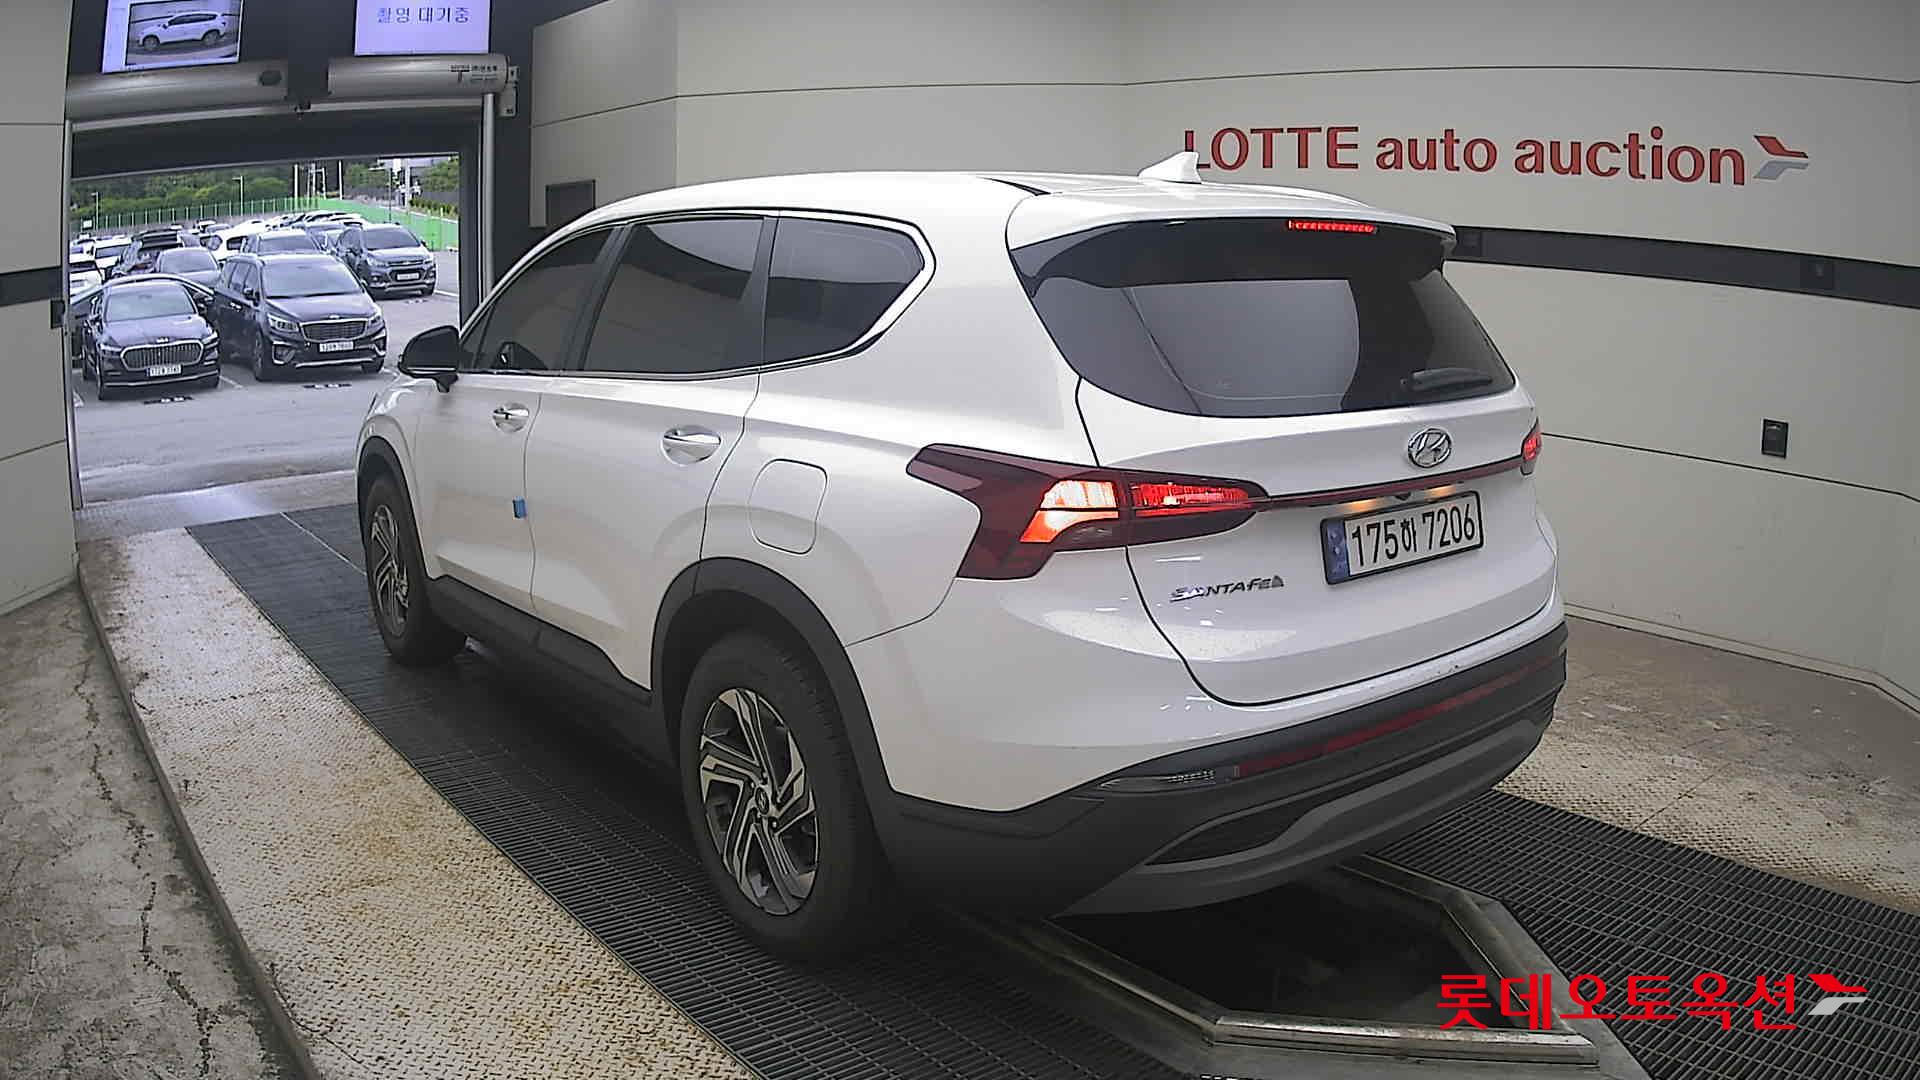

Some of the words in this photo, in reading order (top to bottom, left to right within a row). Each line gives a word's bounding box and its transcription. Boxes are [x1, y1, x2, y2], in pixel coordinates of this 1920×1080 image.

[418, 7, 469, 23] 대기중
[1376, 128, 1497, 172] auto
[1514, 126, 1745, 186] auction
[1351, 517, 1418, 567] 175하
[1422, 503, 1475, 551] 7206
